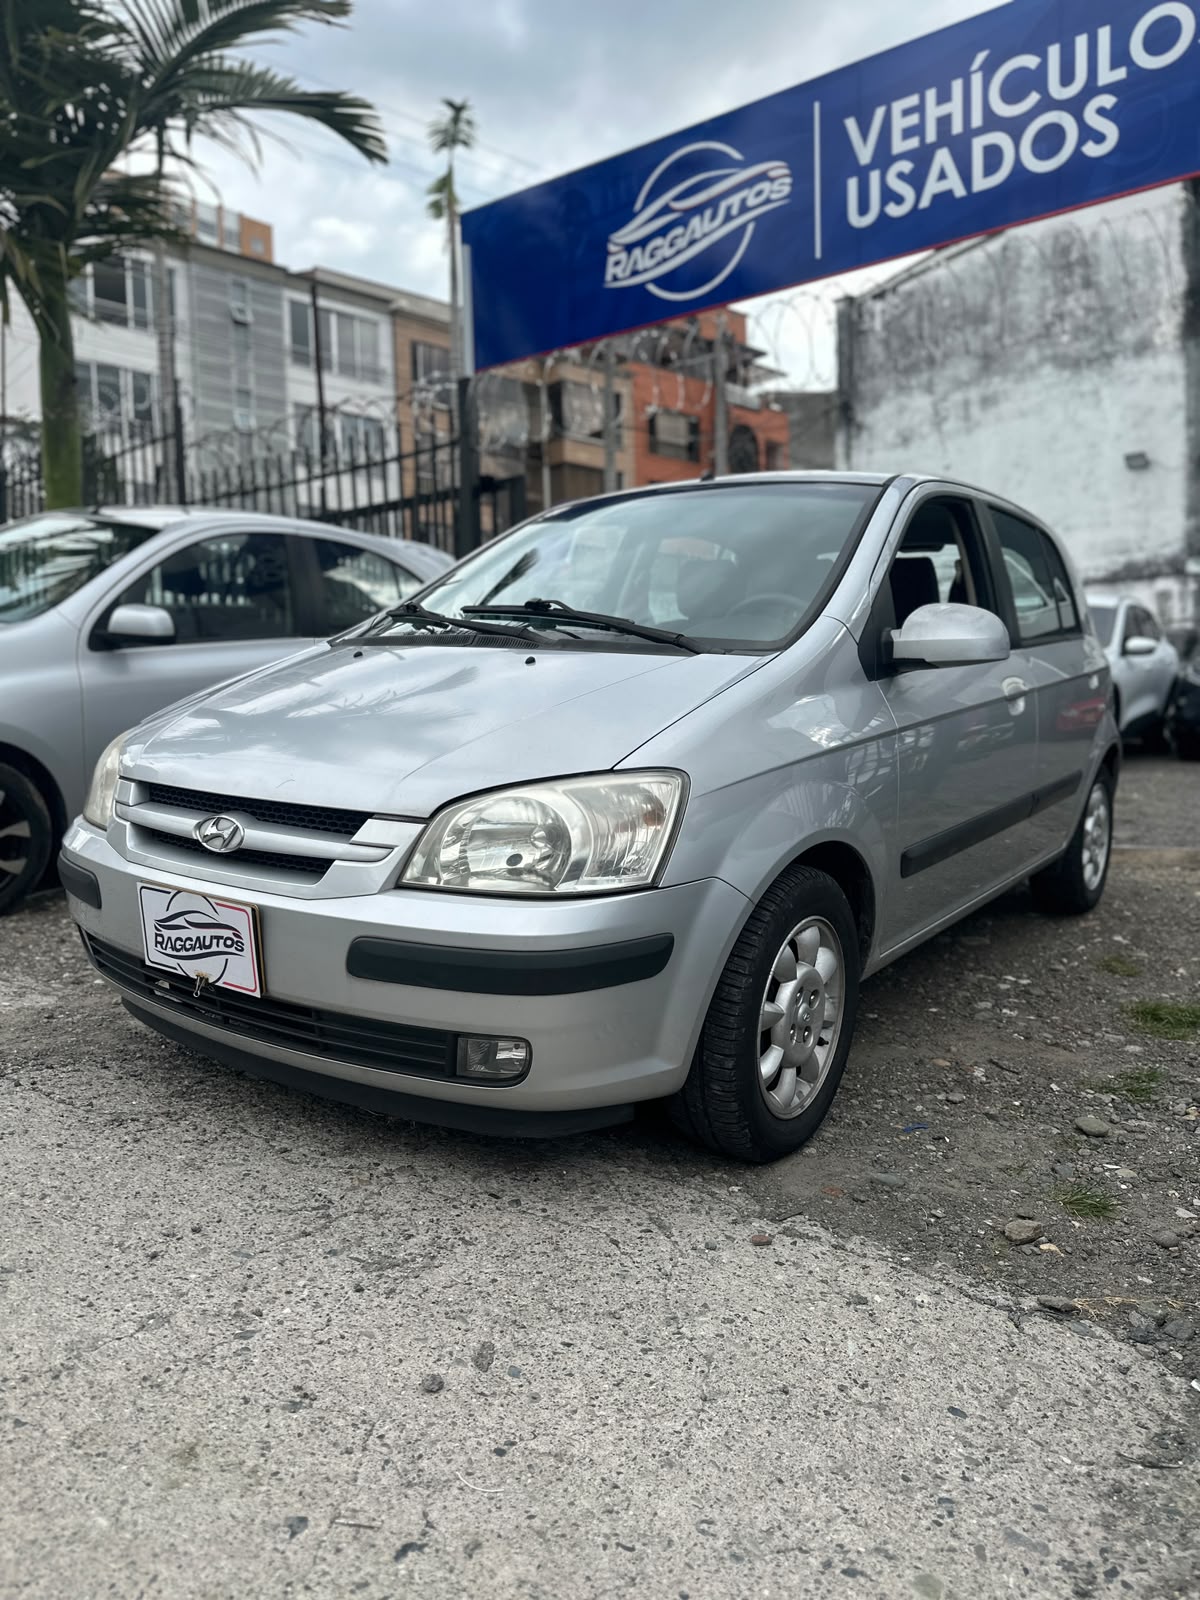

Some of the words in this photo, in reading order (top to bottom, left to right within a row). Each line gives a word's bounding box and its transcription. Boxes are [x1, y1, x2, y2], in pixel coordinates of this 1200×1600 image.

[843, 1, 1200, 166] VEHÍCULO
[846, 93, 1120, 229] USADOS
[604, 176, 793, 283] RAGGAUTOS
[154, 932, 245, 953] RAGGAUTOS
